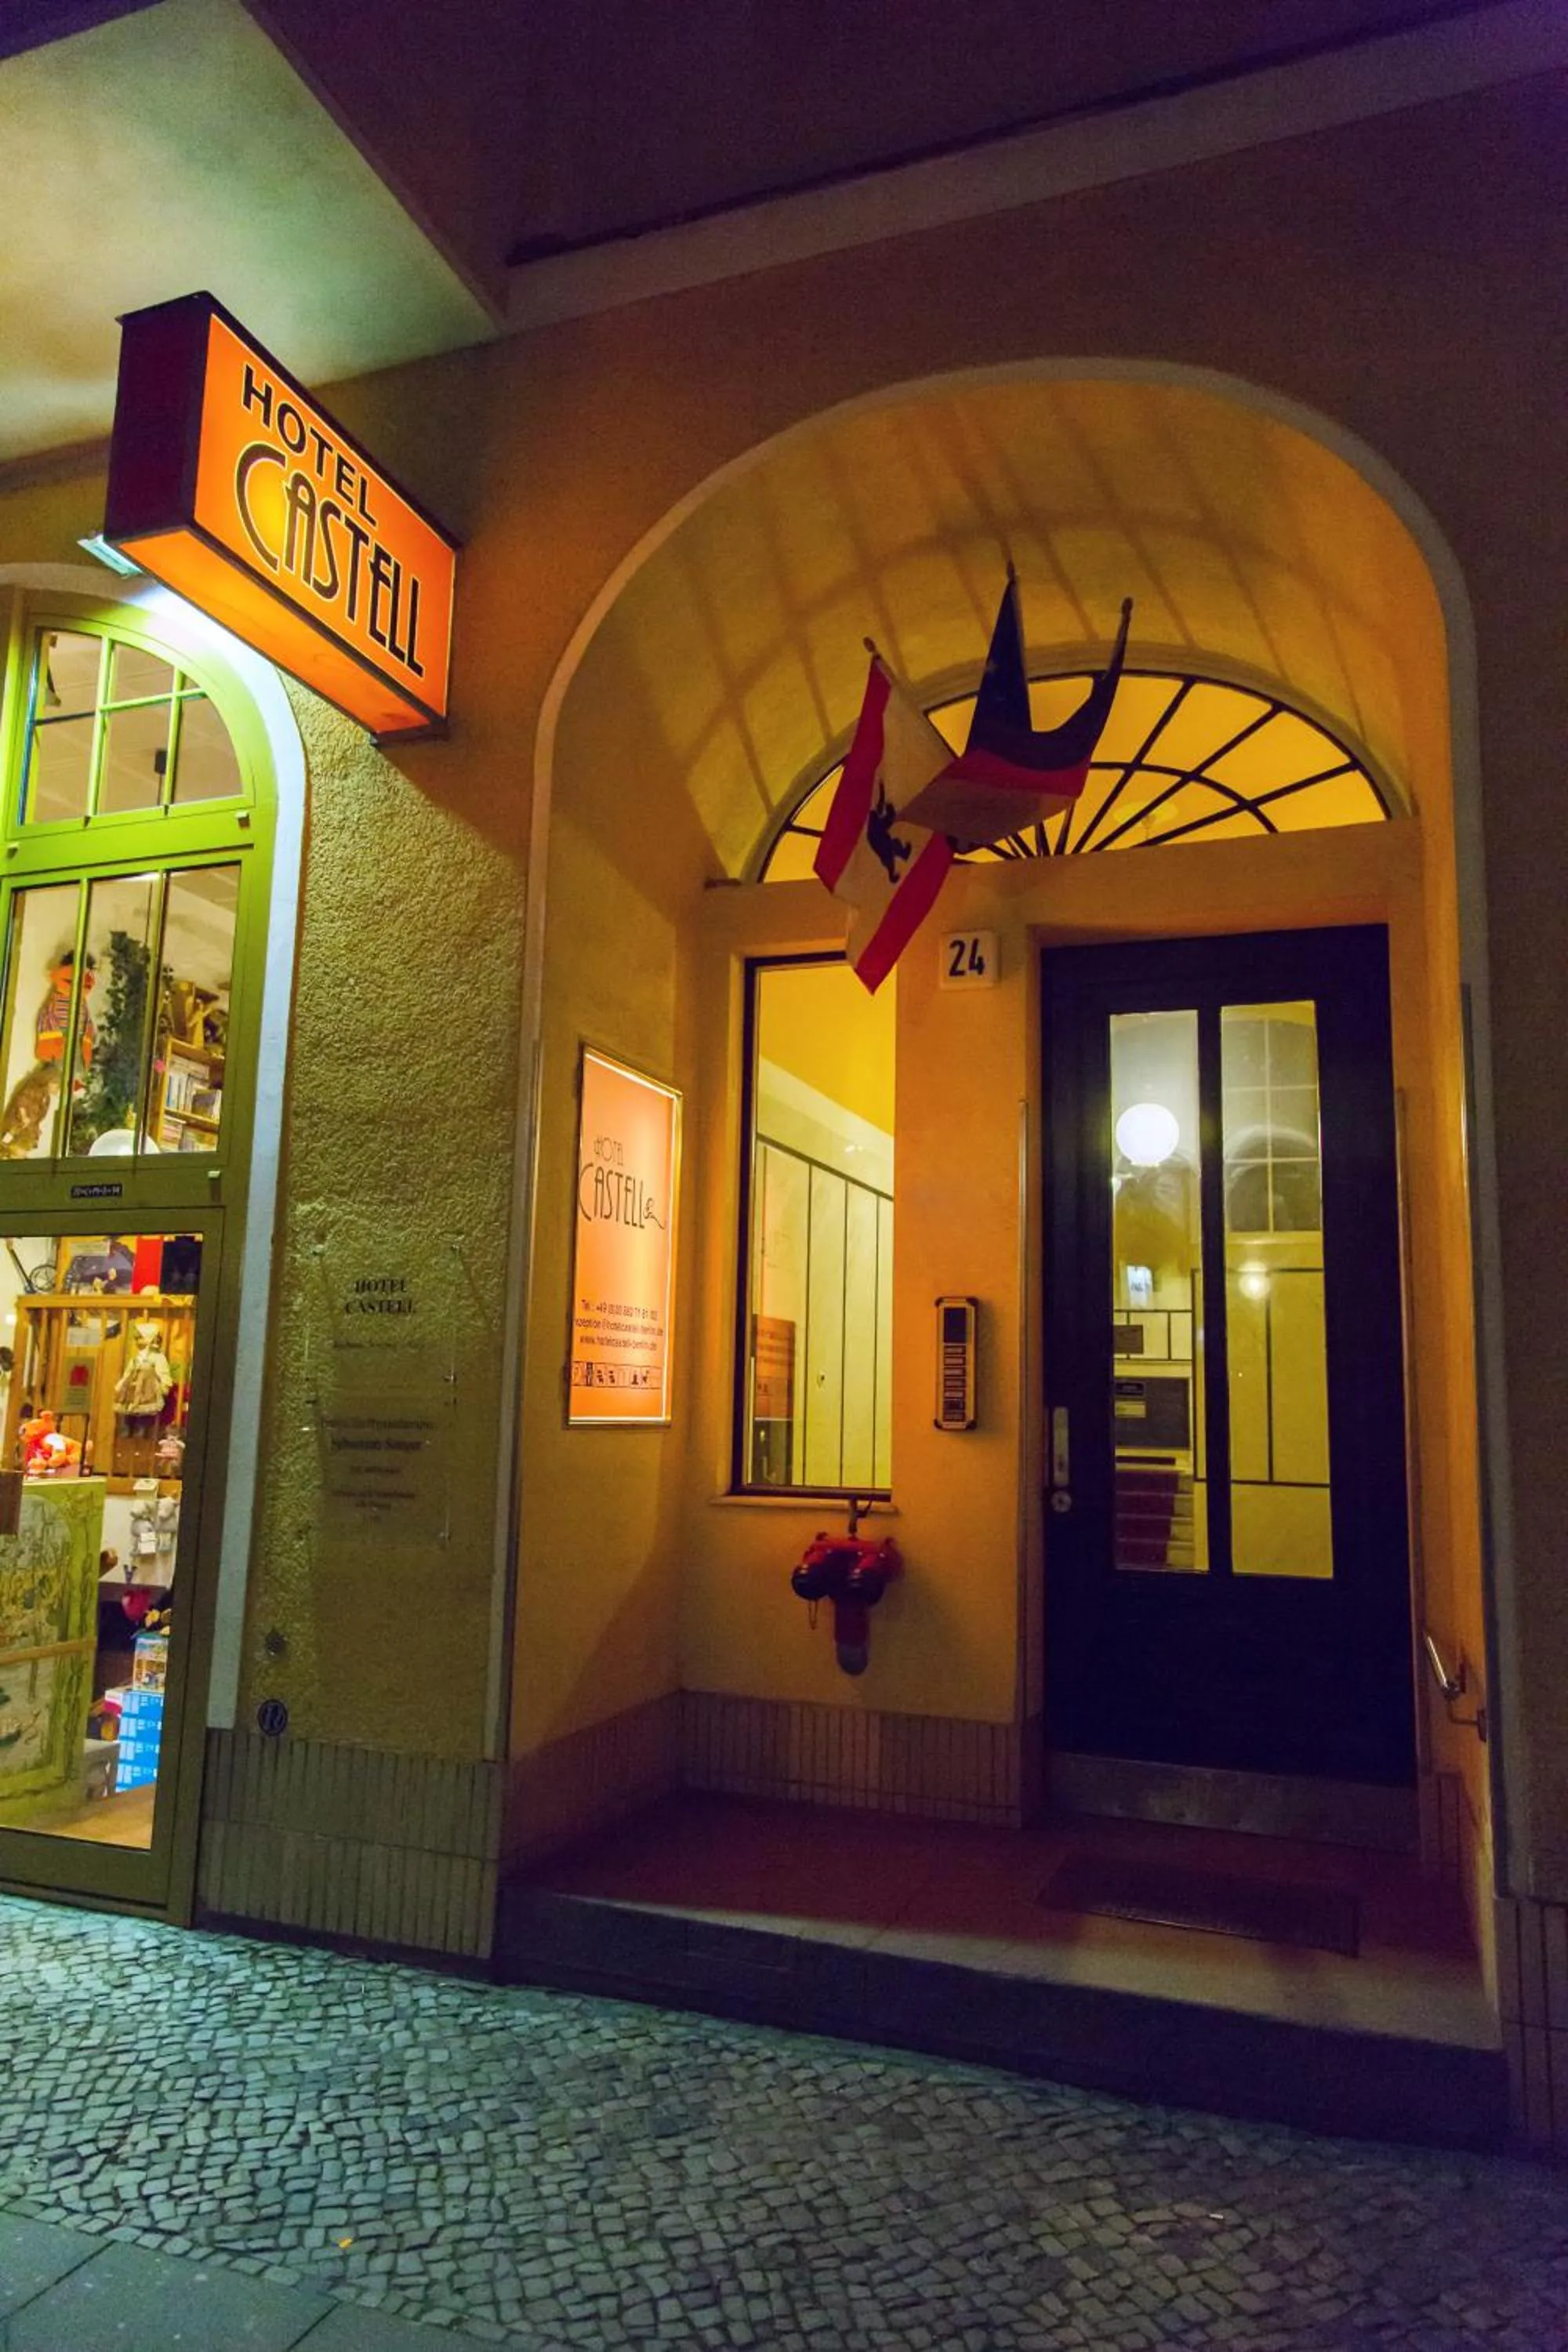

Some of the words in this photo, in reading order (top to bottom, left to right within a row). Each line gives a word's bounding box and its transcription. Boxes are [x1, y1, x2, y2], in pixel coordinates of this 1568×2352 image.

[241, 364, 378, 527] HOTEL
[235, 441, 424, 677] CASTELL
[949, 938, 985, 977] 24
[593, 1134, 624, 1167] HOTEL
[579, 1161, 645, 1229] CASTELL
[355, 1279, 408, 1293] HOTEL
[345, 1300, 417, 1314] CASTELL
